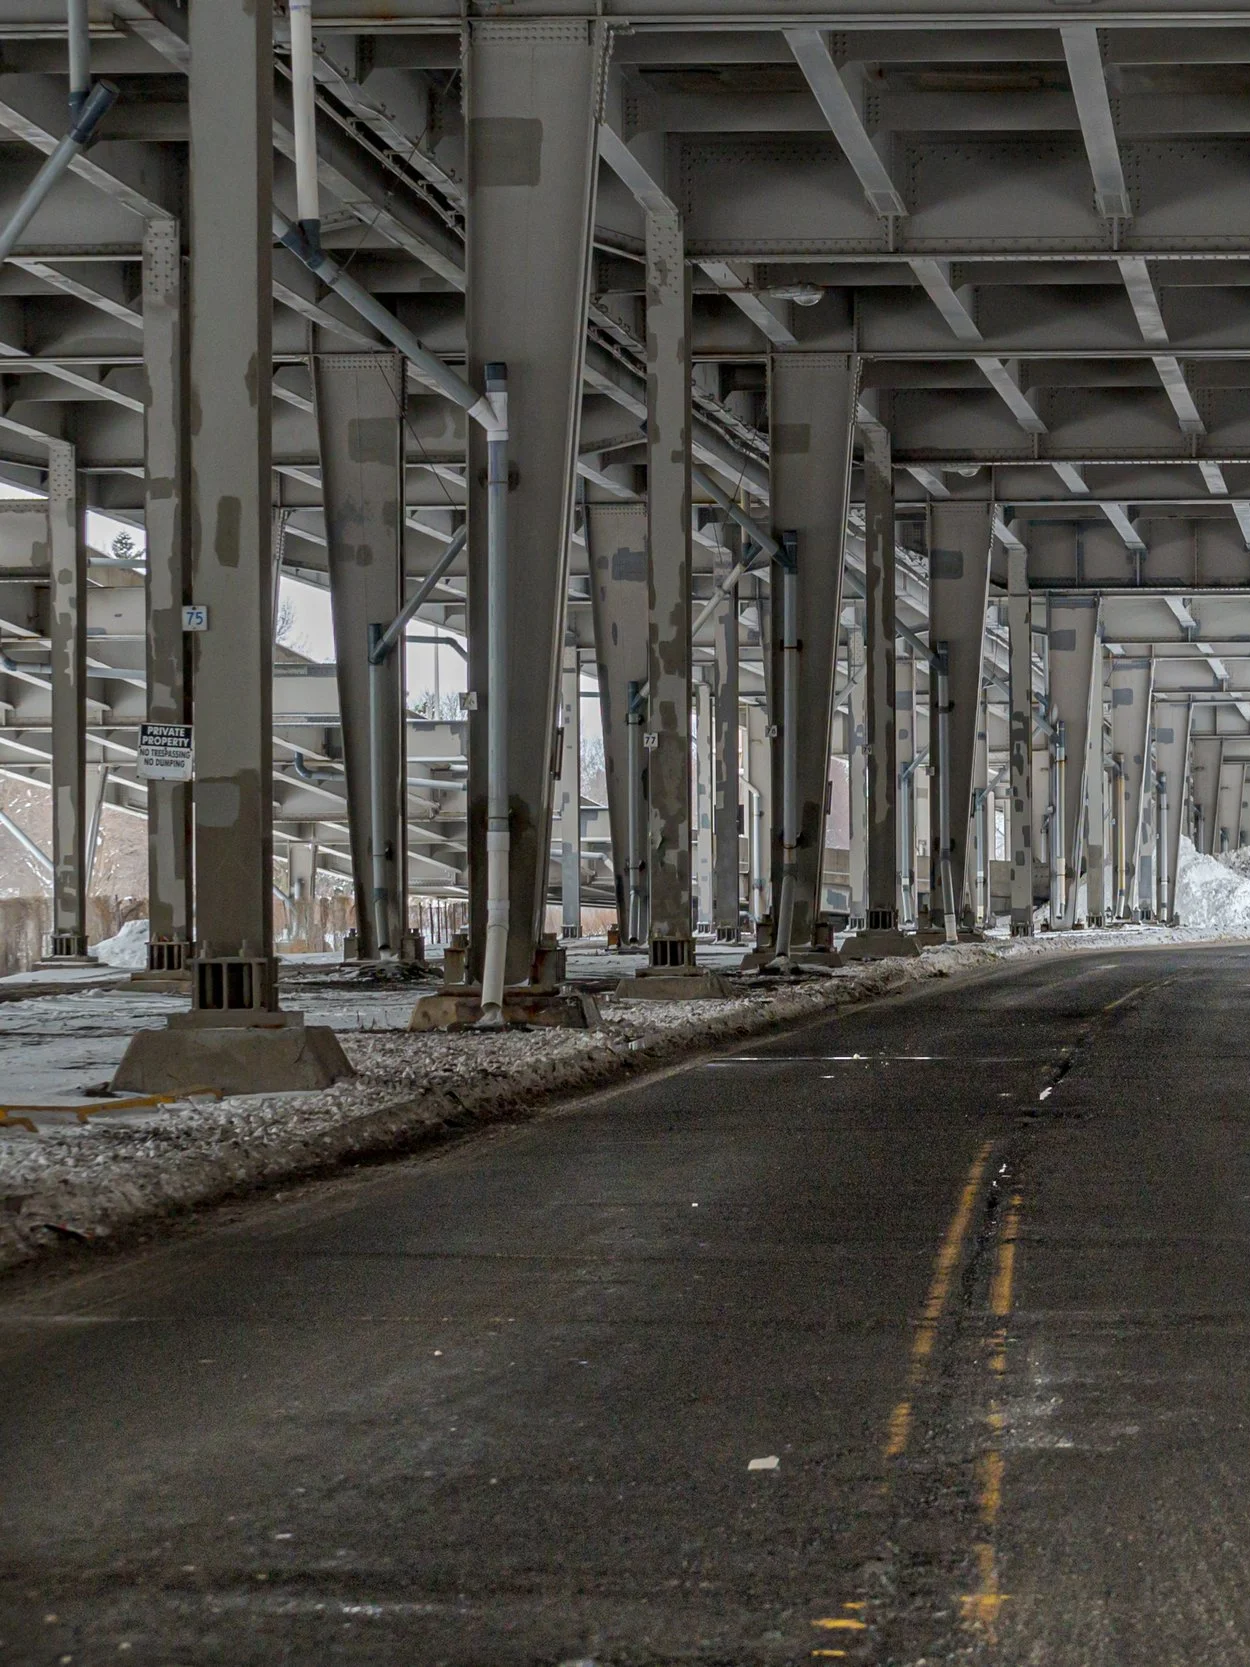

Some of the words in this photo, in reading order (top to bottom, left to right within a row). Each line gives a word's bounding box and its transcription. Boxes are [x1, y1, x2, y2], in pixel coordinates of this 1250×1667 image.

[186, 611, 204, 625] 75
[147, 726, 185, 737] PRIVATE
[142, 736, 190, 747] PROPERTY
[645, 736, 656, 745] 77
[140, 748, 149, 757] NO
[151, 748, 191, 759] TRESPASSING
[144, 758, 154, 766] NO
[155, 759, 185, 768] DUMPING
